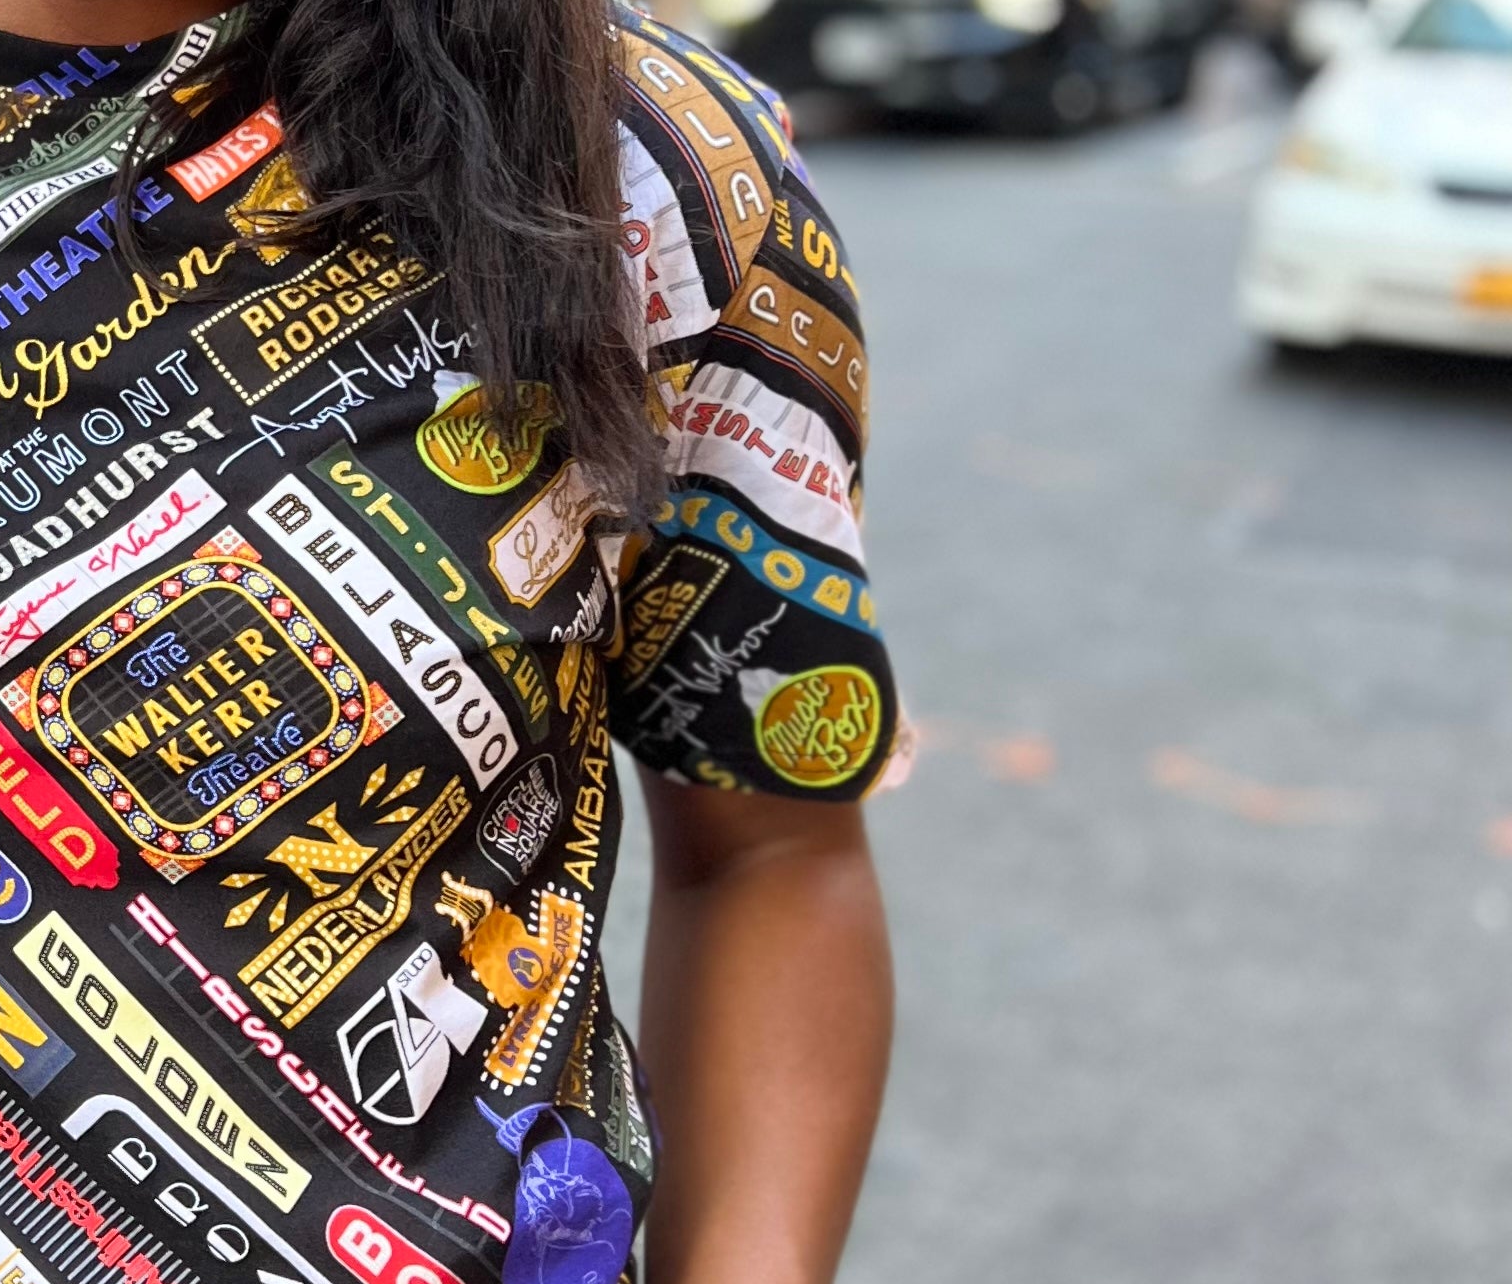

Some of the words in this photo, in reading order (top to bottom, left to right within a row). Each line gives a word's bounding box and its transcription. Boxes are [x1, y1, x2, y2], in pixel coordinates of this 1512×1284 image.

[174, 126, 269, 196] HAYES
[15, 241, 237, 419] Garden
[13, 427, 48, 457] THE
[126, 631, 190, 688] The
[265, 493, 508, 773] BELASCO
[102, 628, 277, 758] WALTER
[156, 679, 283, 775] KERR
[764, 676, 830, 768] Music
[806, 680, 871, 774] Box
[187, 712, 303, 806] Theatre
[249, 786, 468, 1017] NEDERLANDER
[38, 927, 288, 1198] GOLDEN
[126, 893, 511, 1243] HIRSCHFELD
